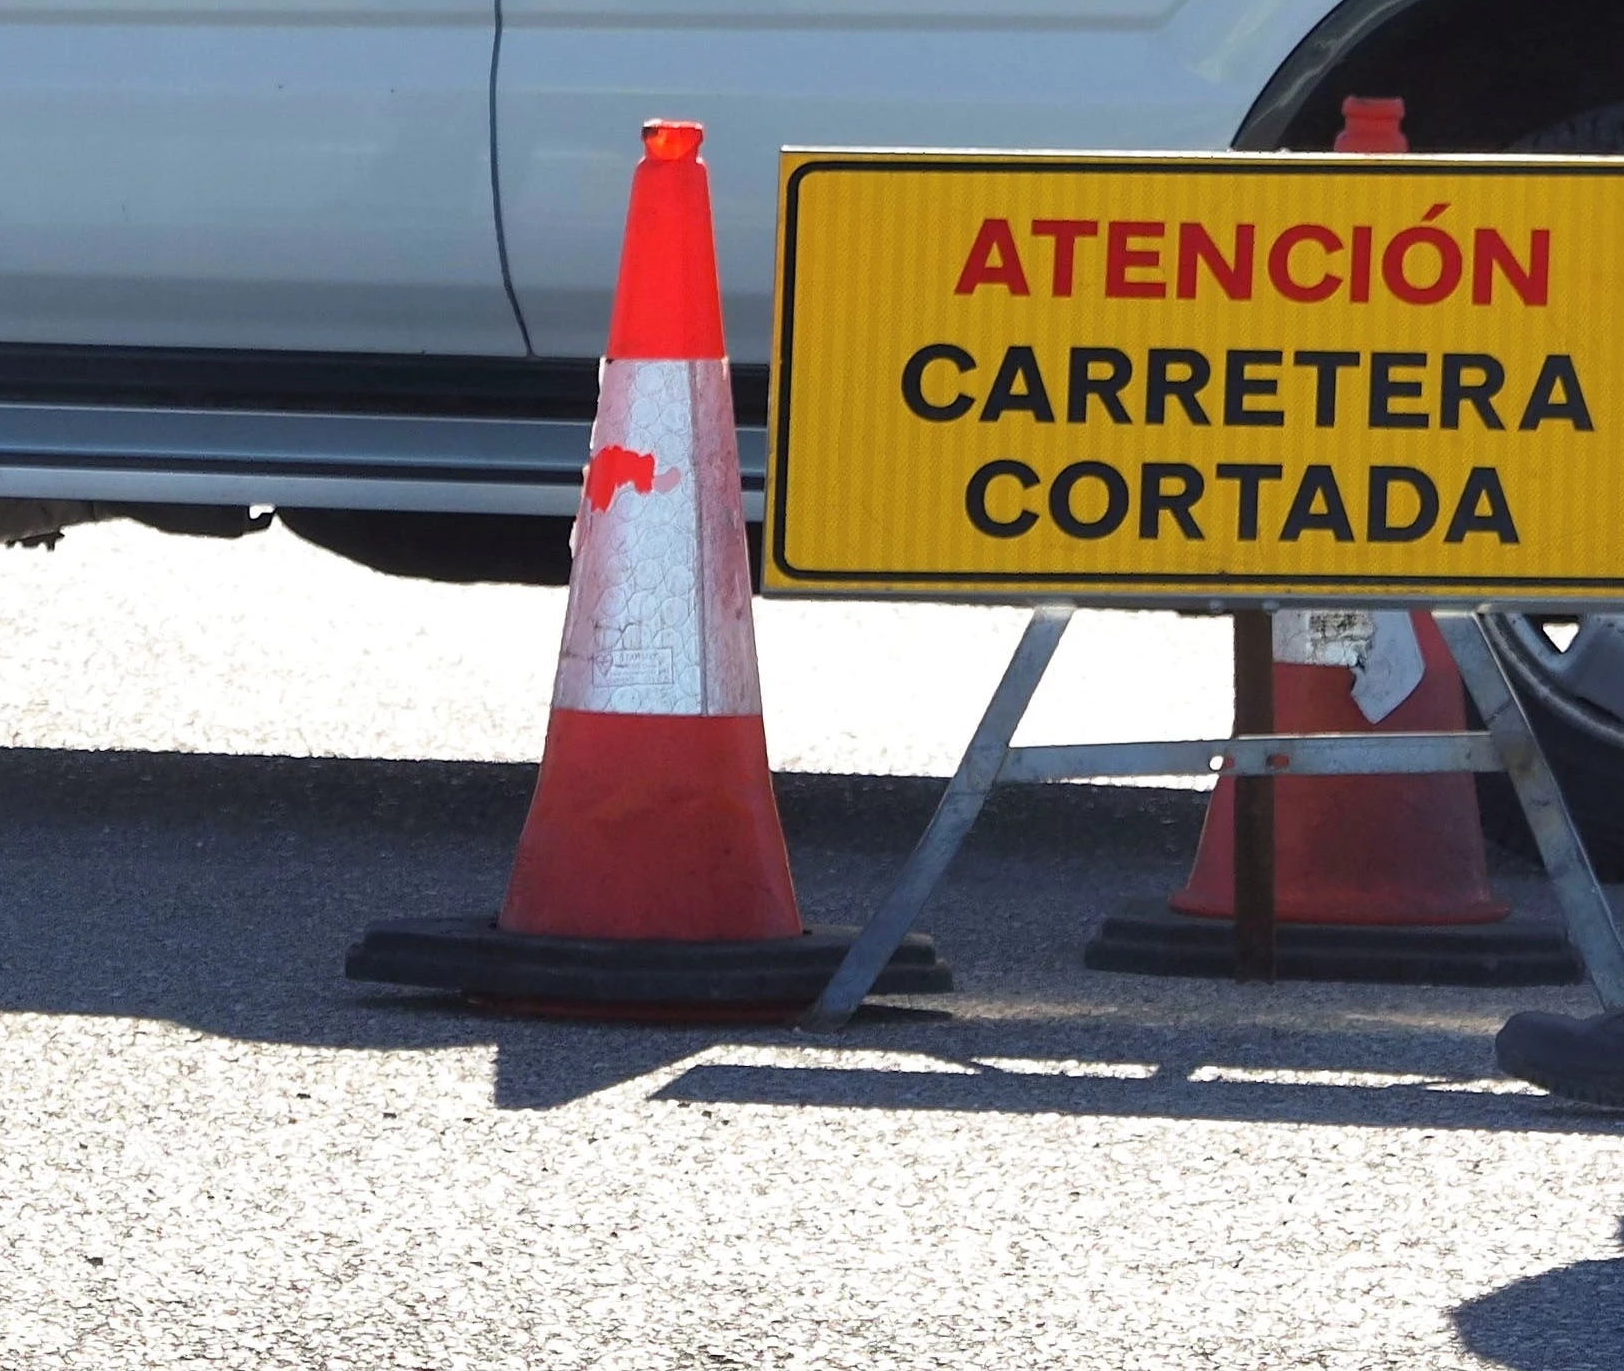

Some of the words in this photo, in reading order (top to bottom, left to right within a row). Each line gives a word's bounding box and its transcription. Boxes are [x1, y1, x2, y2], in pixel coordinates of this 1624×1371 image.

[955, 203, 1551, 307] ATENCIÓN
[901, 343, 1595, 432] CARRETERA
[965, 459, 1520, 544] CORTADA
